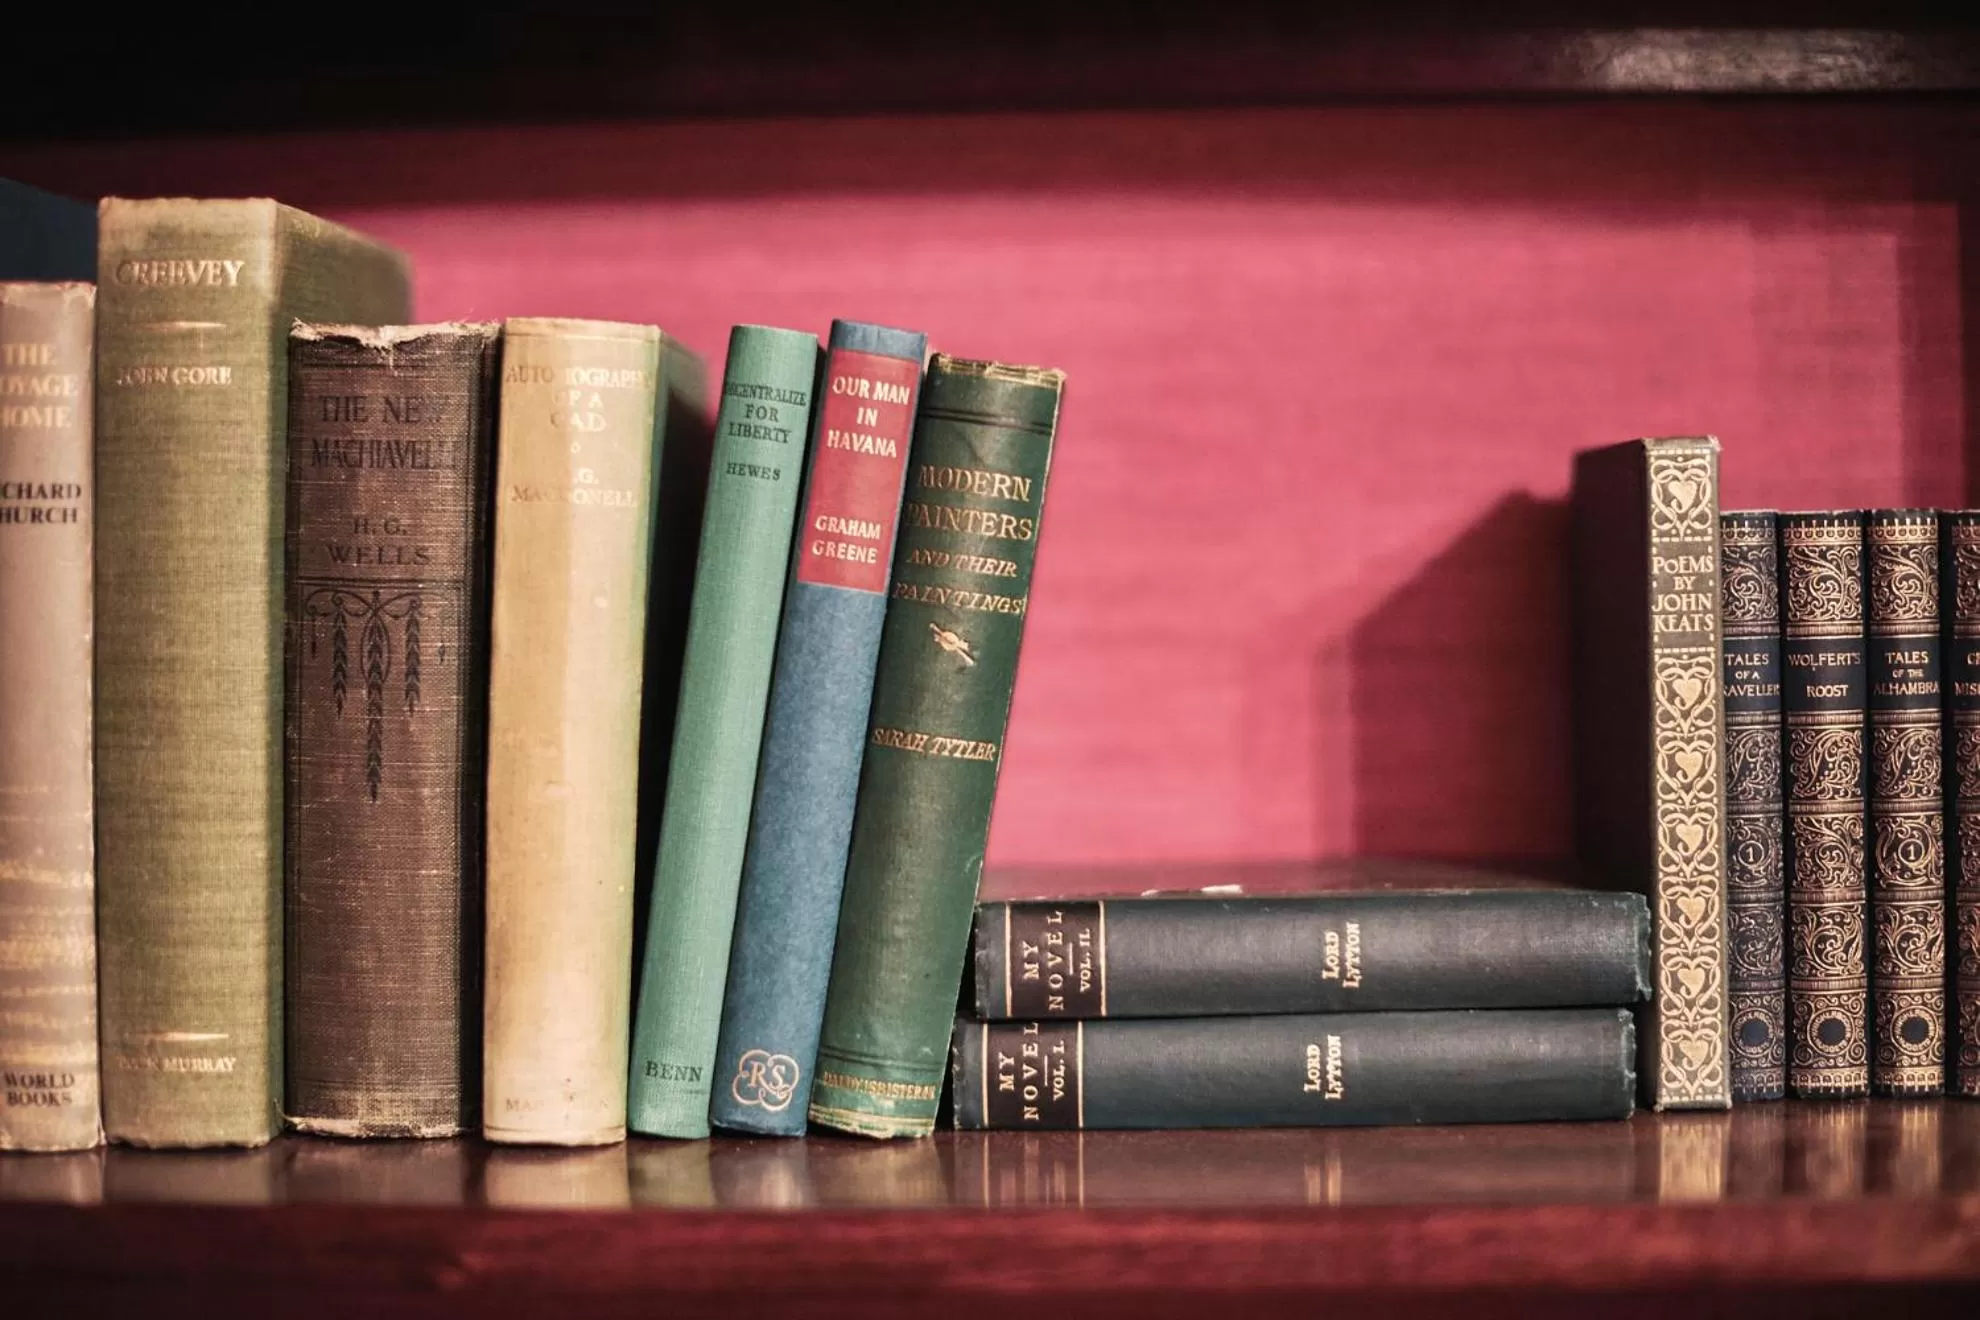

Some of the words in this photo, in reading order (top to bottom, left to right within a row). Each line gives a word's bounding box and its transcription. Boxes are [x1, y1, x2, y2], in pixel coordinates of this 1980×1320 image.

[116, 259, 245, 287] CREEVEY
[3, 343, 57, 366] THE
[0, 374, 79, 397] OYAGE
[171, 365, 232, 386] GORE
[505, 365, 651, 389] AUTOIOGRAPHY
[832, 376, 871, 400] OUR
[873, 381, 910, 405] MAN
[319, 395, 369, 423] THE
[382, 395, 443, 426] NE
[745, 403, 779, 423] FOR
[856, 406, 878, 427] IN
[728, 422, 792, 444] LIBERTY
[827, 429, 897, 458] HAVANA
[726, 462, 781, 481] HEWES
[2, 482, 82, 500] CHARD
[918, 465, 1033, 503] MODERN
[511, 485, 637, 508] MAONELL
[0, 506, 78, 524] HURCH
[907, 503, 1033, 541] PAINTERS
[815, 515, 881, 540] GRAHAM
[325, 542, 431, 567] WELLS
[812, 539, 878, 564] GREENE
[907, 549, 950, 568] AND
[955, 554, 1018, 578] THEIR
[1652, 556, 1714, 575] POEMS
[1672, 576, 1697, 591] BY
[892, 582, 1022, 615] PAINTINGS
[1652, 593, 1713, 612] JOHN
[1652, 613, 1714, 633] KEATS
[1725, 653, 1770, 666] TALES
[1885, 651, 1929, 665] TALES
[1735, 670, 1749, 680] OF
[1751, 670, 1761, 680] A
[1892, 668, 1902, 678] OF
[1907, 668, 1924, 678] THE
[1724, 684, 1780, 697] AVELLER
[1806, 684, 1849, 698] ROOST
[1874, 681, 1940, 697] ALHAMBRA
[872, 728, 930, 753] SARAH
[929, 736, 996, 762] TYTLER
[1022, 940, 1040, 981] MY
[1047, 911, 1064, 1011] NOVEL
[1322, 931, 1340, 979] LORD
[1342, 921, 1362, 988] LYTTON
[1079, 951, 1092, 993] VOL.
[163, 1056, 237, 1073] MURRAY
[645, 1060, 704, 1083] BENN
[998, 1052, 1015, 1092] MY
[1022, 1022, 1039, 1120] NOVEL
[1304, 1044, 1321, 1092] LORD
[1325, 1034, 1344, 1100] LYTTON
[4, 1072, 75, 1088] WORLD
[1053, 1059, 1065, 1101] VOL.
[8, 1091, 73, 1107] BOOKS
